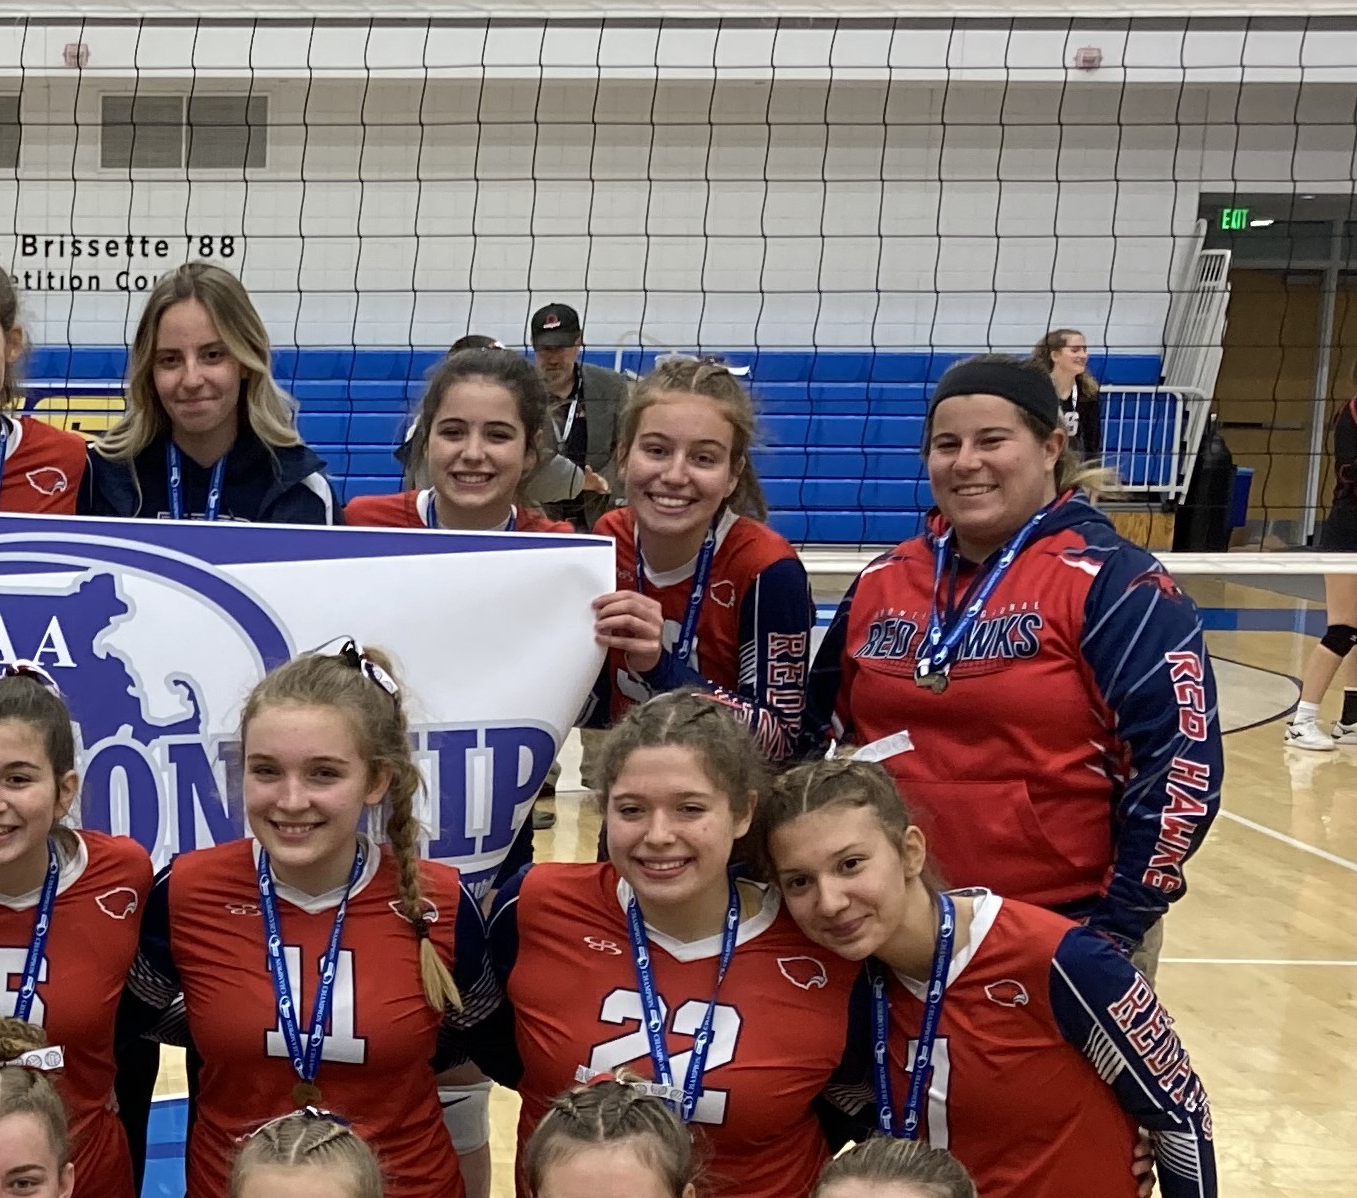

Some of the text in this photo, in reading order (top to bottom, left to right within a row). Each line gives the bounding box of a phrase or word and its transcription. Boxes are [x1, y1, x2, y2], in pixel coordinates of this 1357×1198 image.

[1221, 208, 1248, 229] EXIT
[22, 235, 169, 258] Brissette
[853, 618, 917, 660] RED
[1141, 651, 1210, 893] RED HAWKS
[266, 896, 276, 935] CHAMPION
[631, 907, 643, 946] CHAMPION
[28, 937, 41, 976] CHAMPION
[276, 957, 287, 996] CHAMPION
[642, 970, 655, 1010] CHAMPION
[267, 946, 365, 1064] 11
[316, 985, 329, 1024] CHAMPION
[877, 1001, 885, 1040] CHAMPION
[921, 1004, 935, 1044] CHAMPION
[287, 1019, 301, 1058] CHAMPION
[590, 988, 741, 1124] 22
[654, 1034, 668, 1073] CHAMPION
[689, 1057, 703, 1096] CHAMPION
